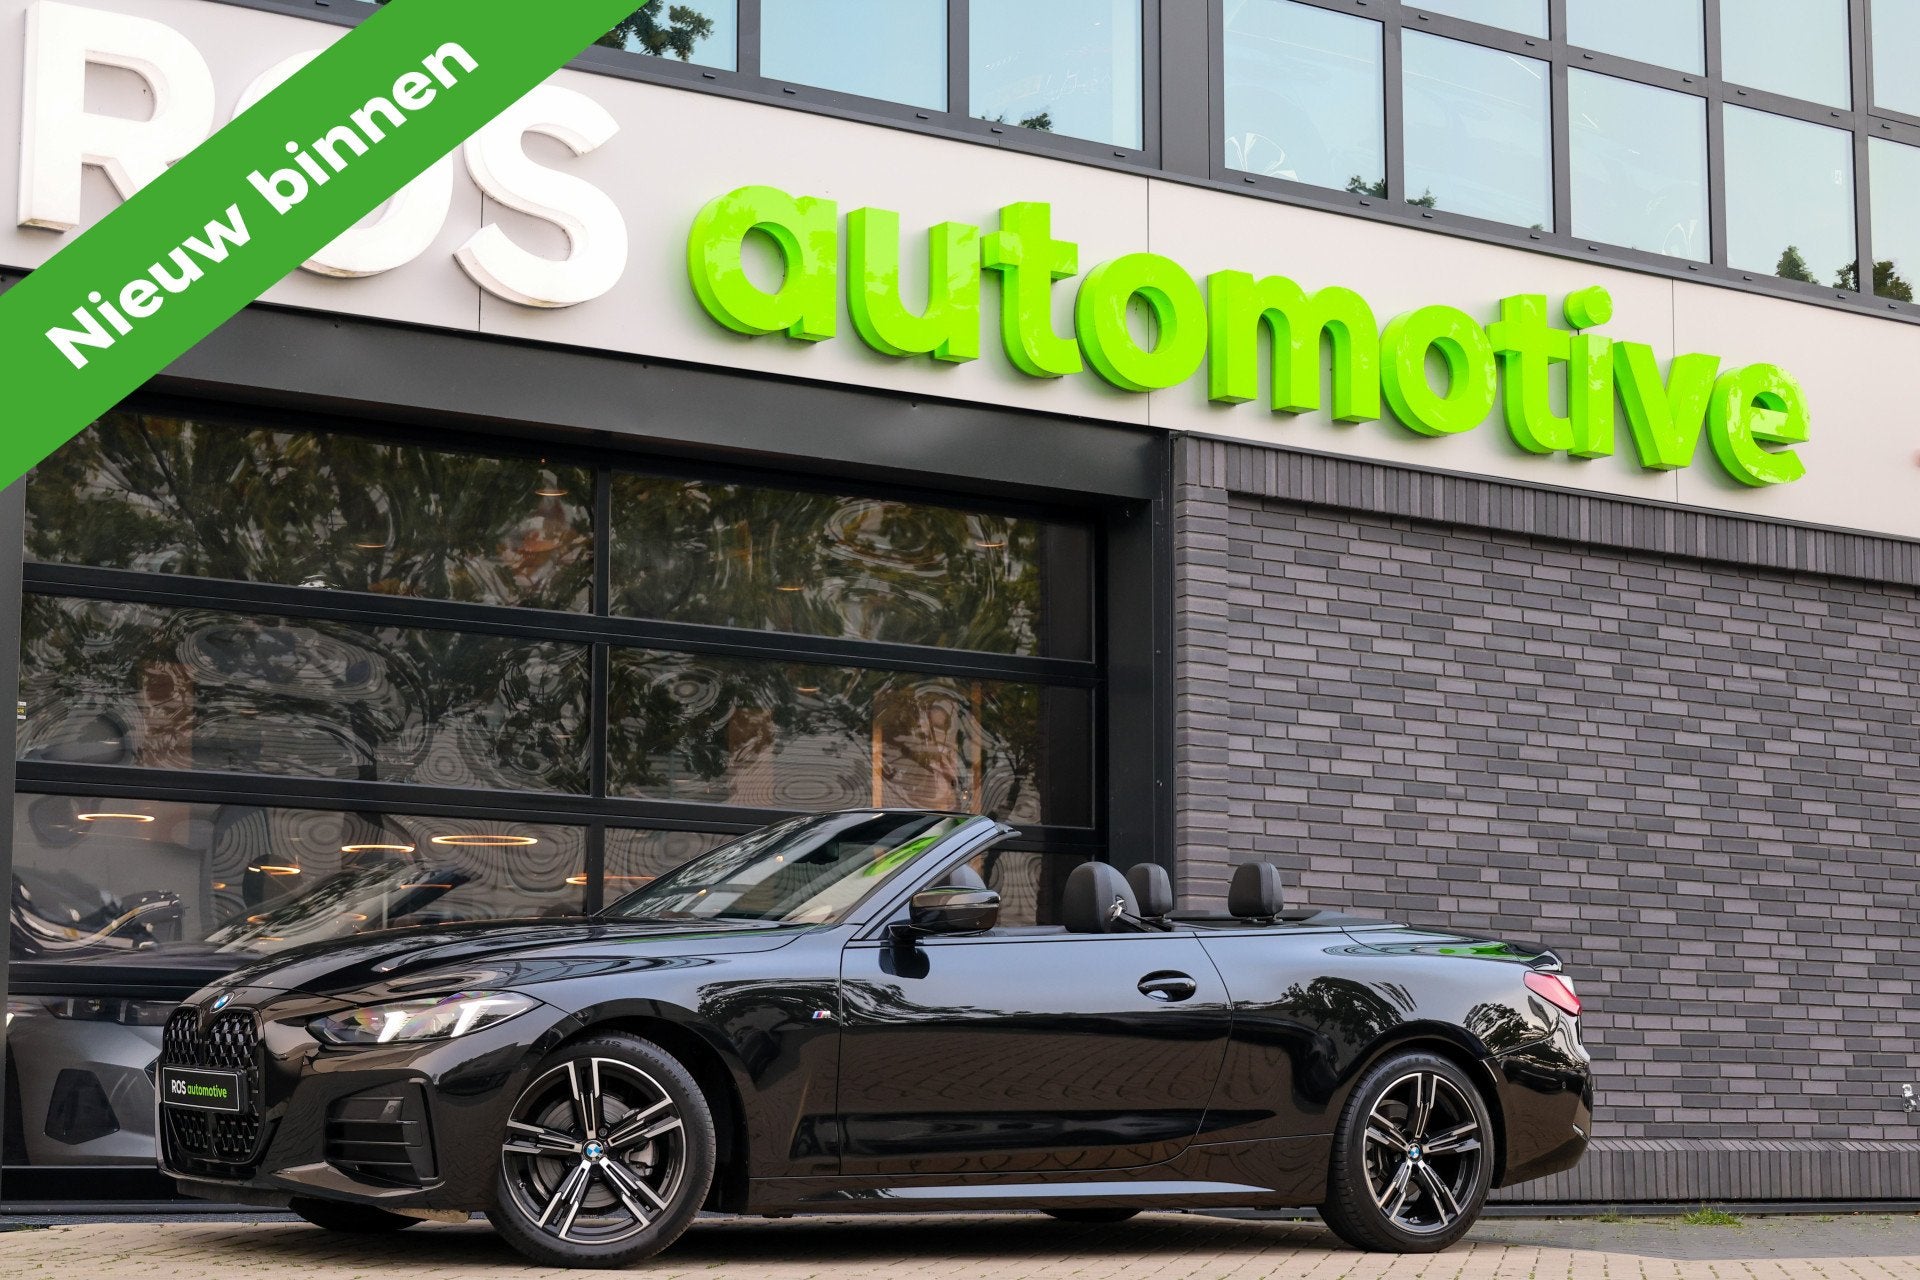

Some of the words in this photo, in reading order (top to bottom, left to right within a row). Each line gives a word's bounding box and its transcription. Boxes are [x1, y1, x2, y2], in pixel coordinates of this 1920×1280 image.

[686, 184, 1811, 488] automotive
[171, 1079, 187, 1095] ROS
[187, 1084, 228, 1098] automotive
